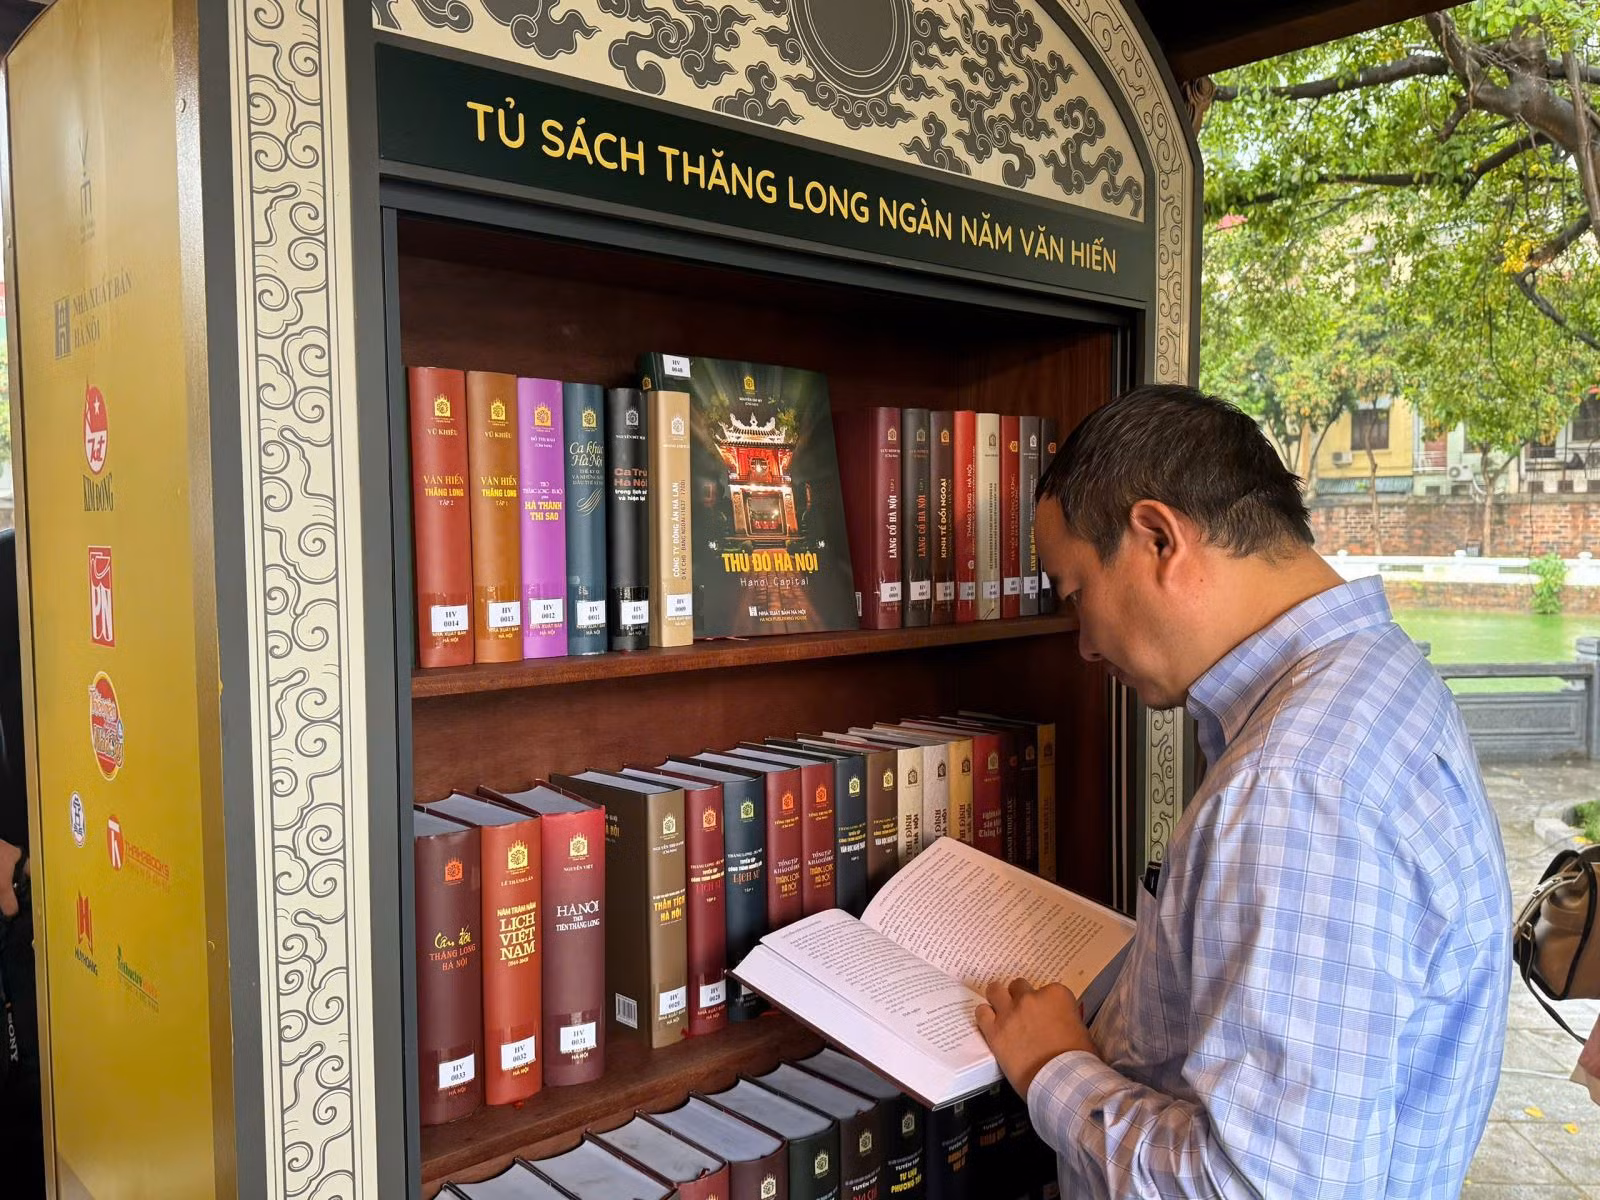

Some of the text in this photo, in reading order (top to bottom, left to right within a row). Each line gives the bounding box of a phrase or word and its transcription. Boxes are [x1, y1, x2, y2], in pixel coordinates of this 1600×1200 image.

[466, 97, 1117, 274] TỦ SÁCH THĂNG LONG NGÀN NĂM VĂN HIẾN
[569, 442, 584, 454] Ca
[614, 468, 632, 476] Ca
[632, 478, 648, 487] Nội
[425, 487, 464, 497] THĂNG LONG
[481, 487, 517, 497] THĂNG LONG
[940, 478, 948, 506] NGOẠI
[888, 495, 898, 509] NỘI
[917, 495, 926, 509] NỘI
[530, 512, 559, 520] THI SAO
[888, 511, 897, 522] HÀ
[917, 511, 926, 522] HÀ
[938, 508, 947, 523] ĐỐI
[938, 525, 947, 535] TẾ
[672, 546, 680, 555] TY
[888, 537, 897, 558] LÀNG
[917, 536, 926, 557] LÀNG
[721, 550, 819, 574] THỦ ĐÔ HÀ NỘI
[740, 577, 809, 588] Hanoi Capital
[733, 872, 752, 885] LỊCH
[654, 895, 686, 911] THẦN TÍCH
[660, 911, 670, 922] HÀ
[671, 908, 682, 919] NỘI
[499, 912, 536, 932] LỊCH
[587, 919, 600, 928] LONG
[499, 926, 535, 946] VIỆT
[429, 943, 476, 961] THĂNG LONG
[499, 940, 536, 961] NAM
[442, 957, 468, 971] HÀ NỘI
[710, 986, 719, 994] HV
[670, 993, 679, 1001] HV
[573, 1029, 585, 1037] HV
[571, 1038, 586, 1046] 0031
[514, 1044, 526, 1053] HV
[512, 1053, 527, 1062] 0032
[453, 1063, 465, 1072] HV
[450, 1072, 466, 1081] 0033
[852, 1181, 870, 1191] TUYỂN
